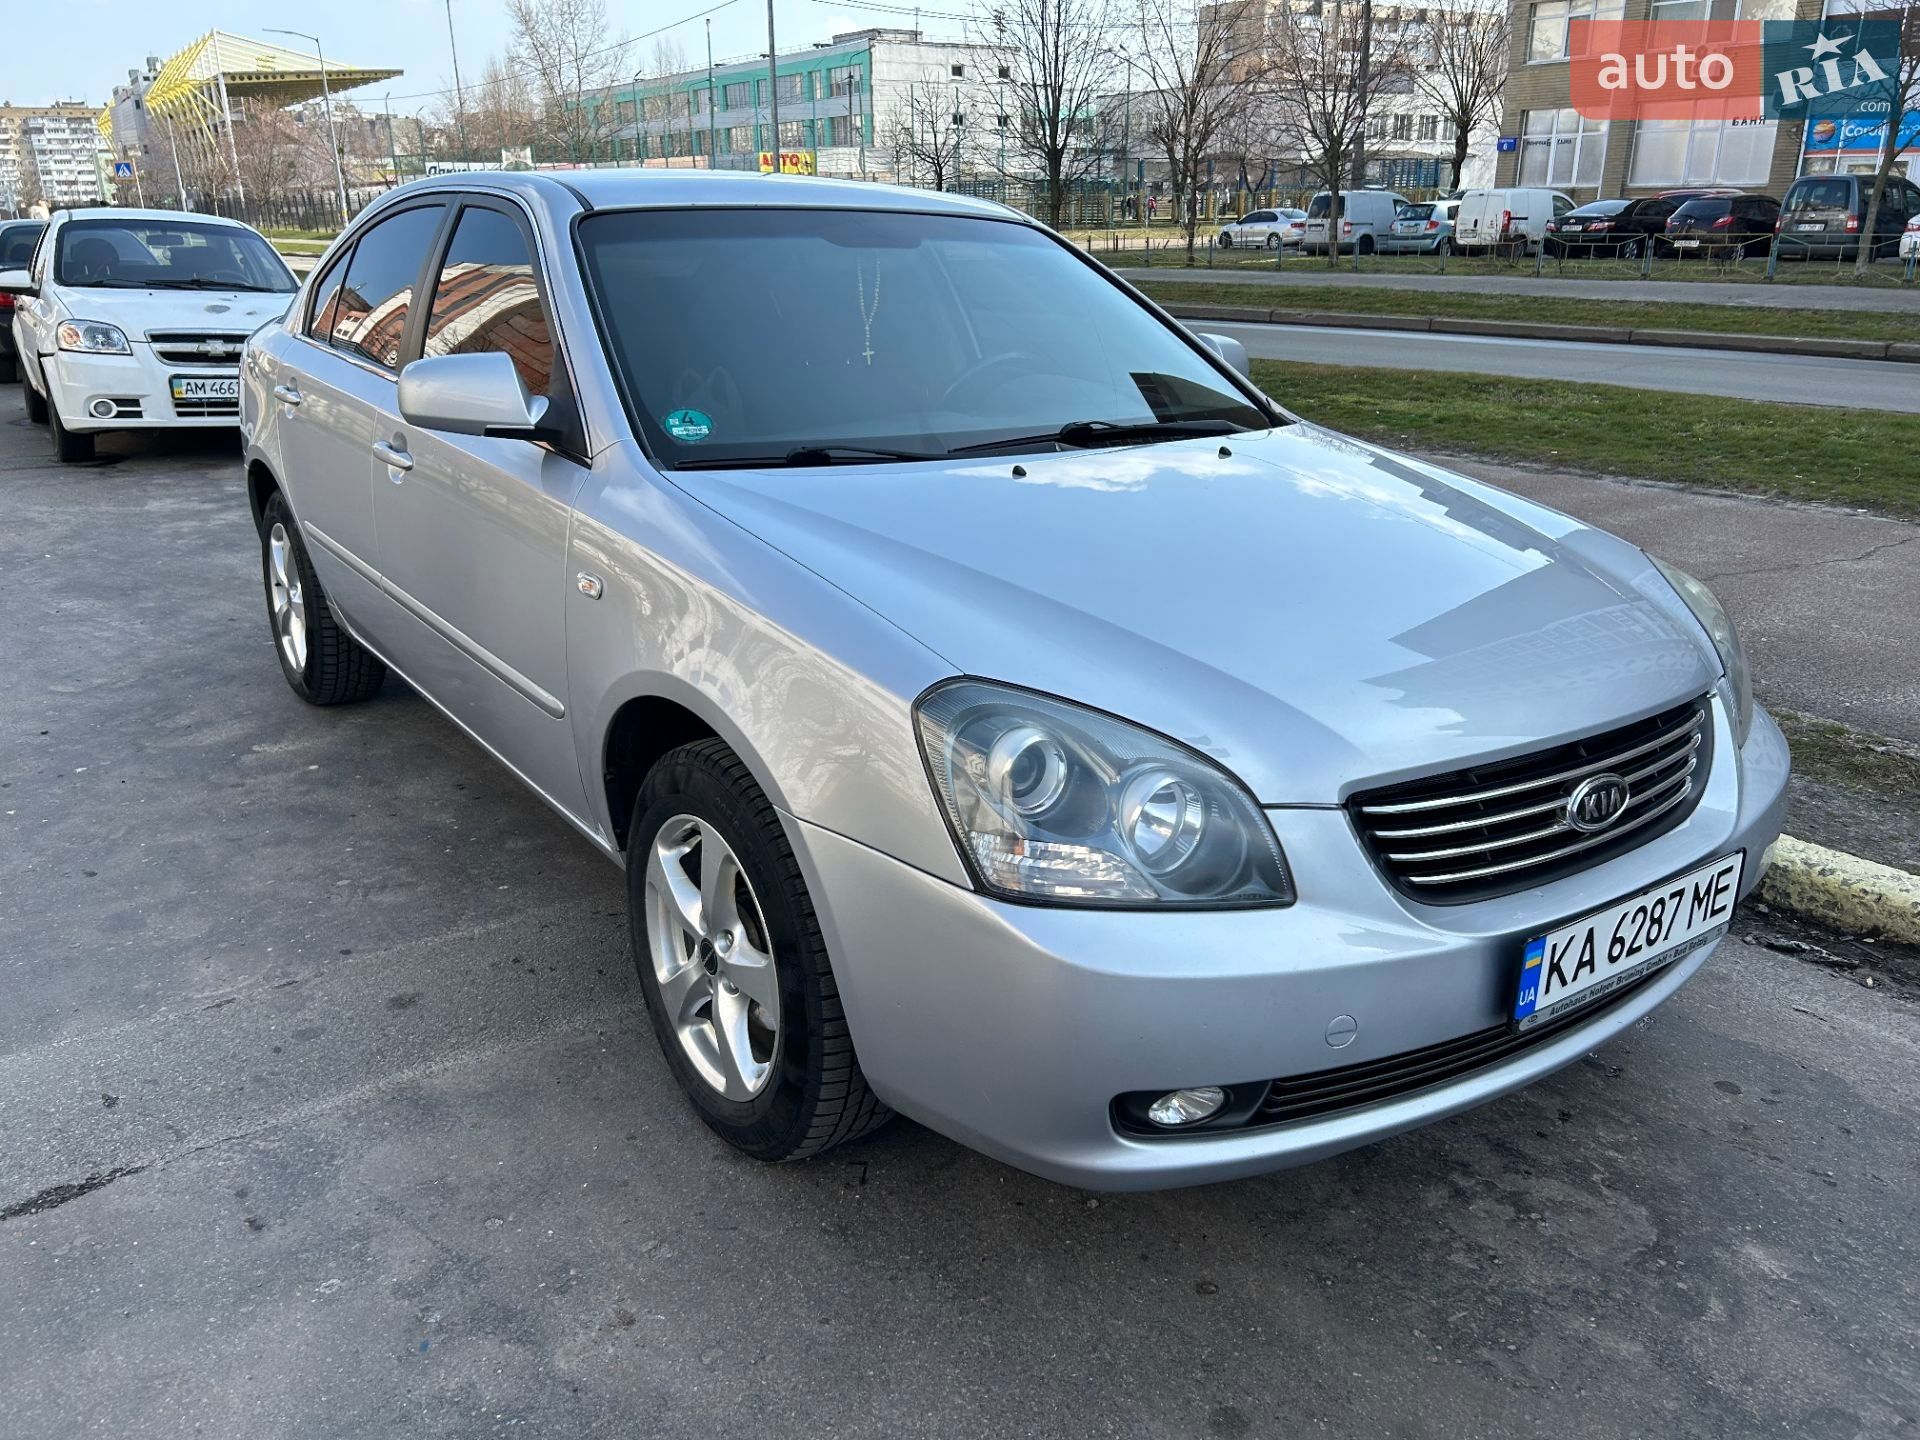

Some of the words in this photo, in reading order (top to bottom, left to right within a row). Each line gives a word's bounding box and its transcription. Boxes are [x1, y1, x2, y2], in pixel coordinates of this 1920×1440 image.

[1732, 115, 1766, 127] БАНЯ
[185, 381, 207, 395] AM
[681, 411, 695, 425] 4
[1584, 786, 1622, 821] KIA
[1544, 926, 1596, 996] KA
[1607, 886, 1686, 965] 6287
[1686, 864, 1734, 931] ME
[1519, 986, 1536, 1006] UA
[1550, 993, 1587, 1017] Autohaus
